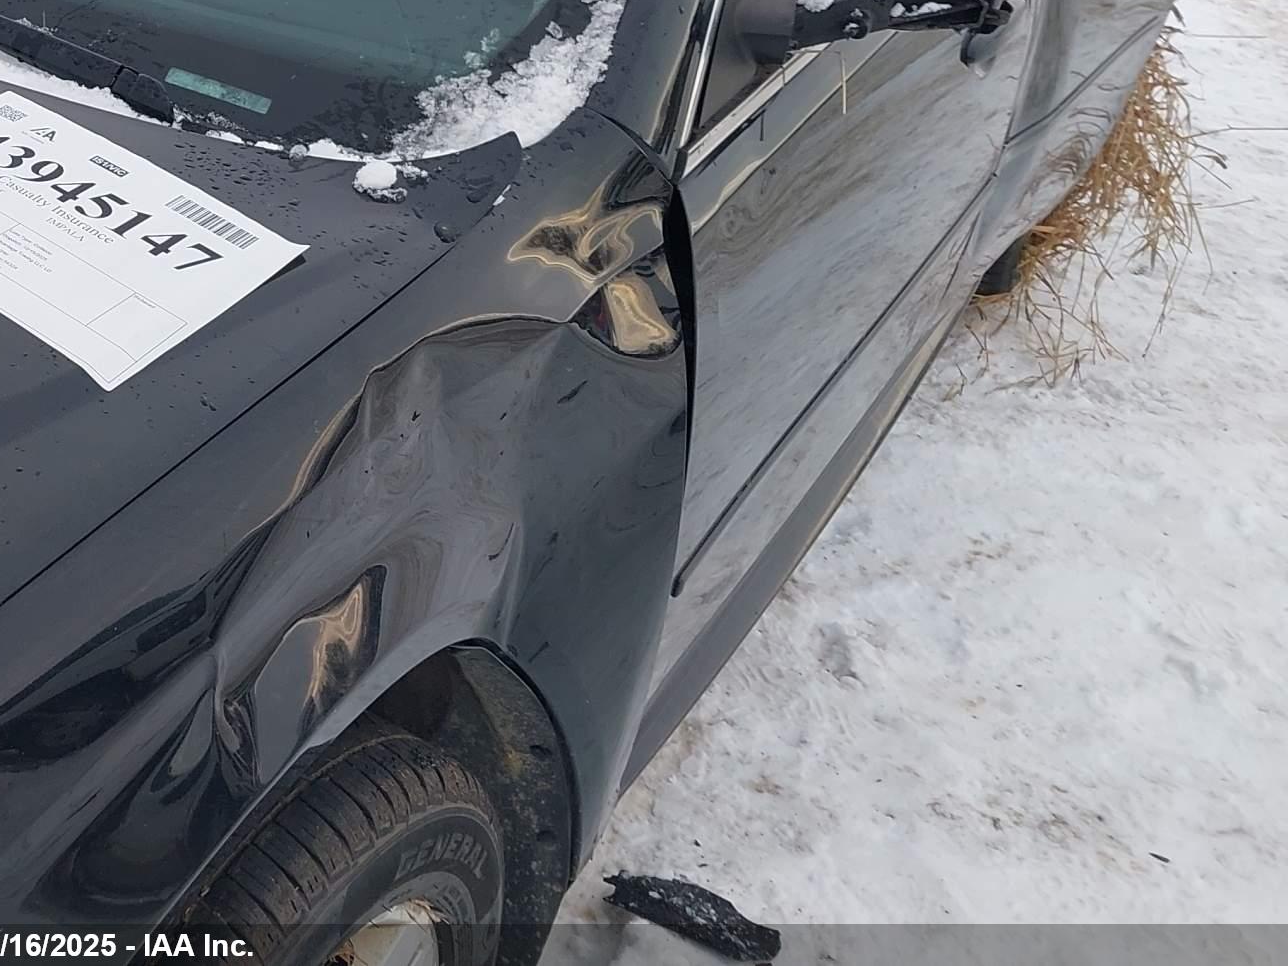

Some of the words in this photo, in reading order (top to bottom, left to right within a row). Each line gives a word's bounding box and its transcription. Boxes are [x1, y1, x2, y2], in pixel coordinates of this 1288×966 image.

[45, 216, 86, 243] IMPALA
[51, 205, 115, 244] Insurance
[395, 832, 488, 880] GENERAL
